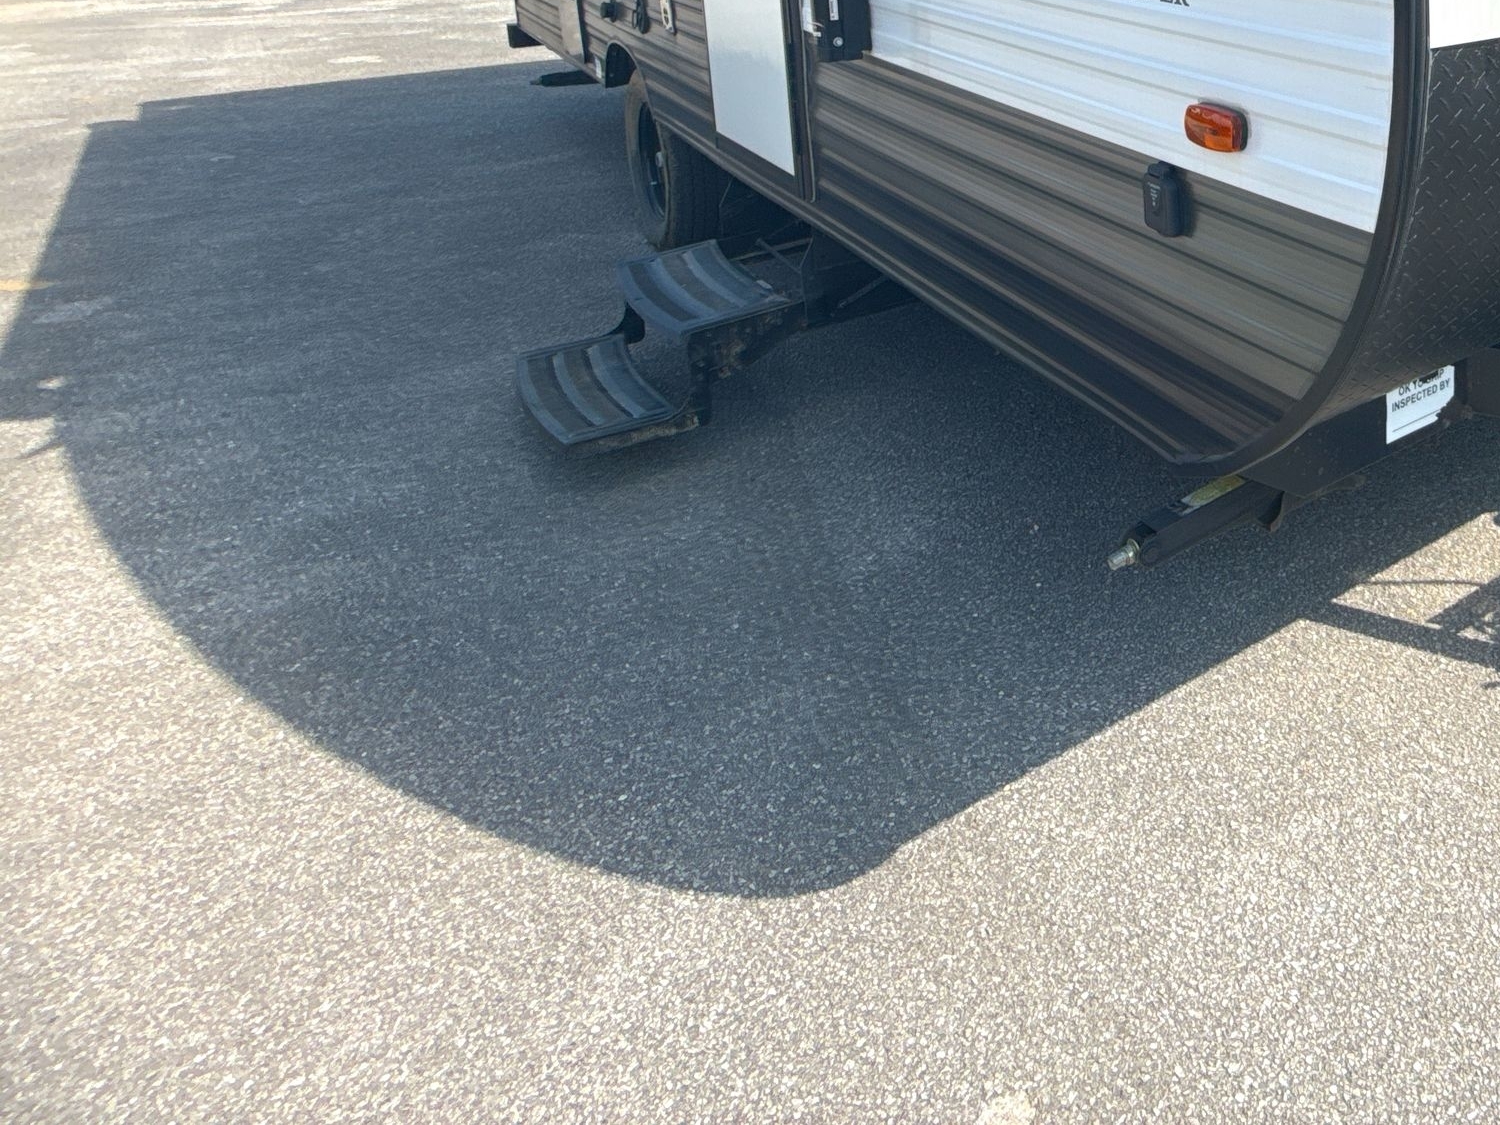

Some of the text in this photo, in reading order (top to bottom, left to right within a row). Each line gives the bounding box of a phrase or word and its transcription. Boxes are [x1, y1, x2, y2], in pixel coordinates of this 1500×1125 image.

[1391, 377, 1451, 413] INSPECTED BY
[1398, 383, 1411, 396] OK
